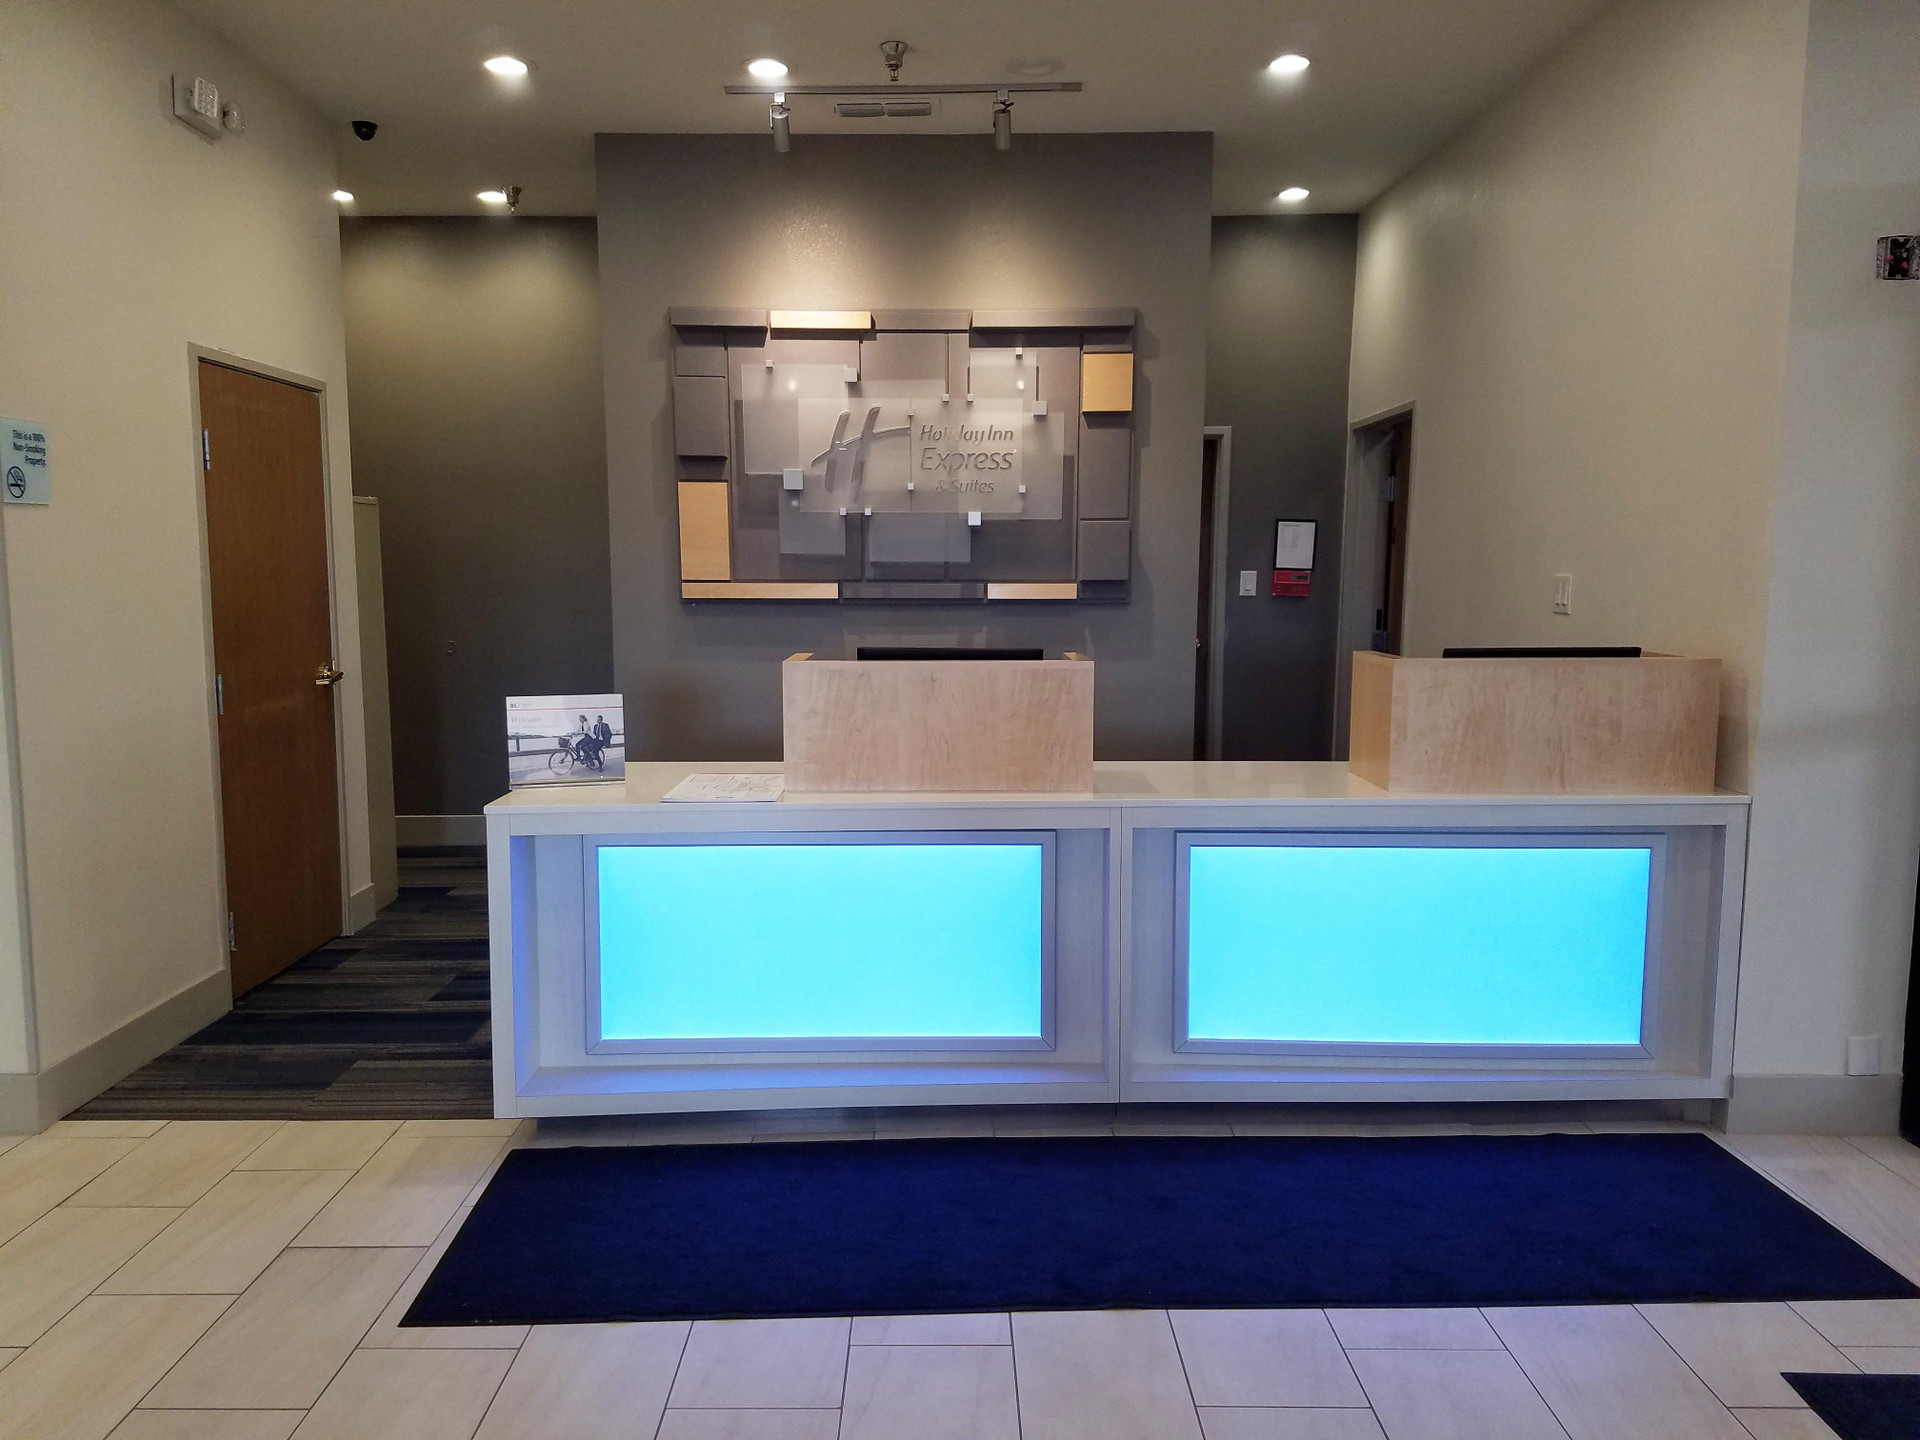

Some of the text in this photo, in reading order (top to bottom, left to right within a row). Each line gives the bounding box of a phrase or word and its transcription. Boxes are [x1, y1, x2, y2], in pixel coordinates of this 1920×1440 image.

[13, 429, 23, 439] This
[32, 433, 45, 442] 100%
[920, 424, 1014, 445] Holiday Inn
[13, 441, 46, 456] Non-Smoking
[920, 447, 1014, 476] Express
[935, 478, 995, 494] & Suites
